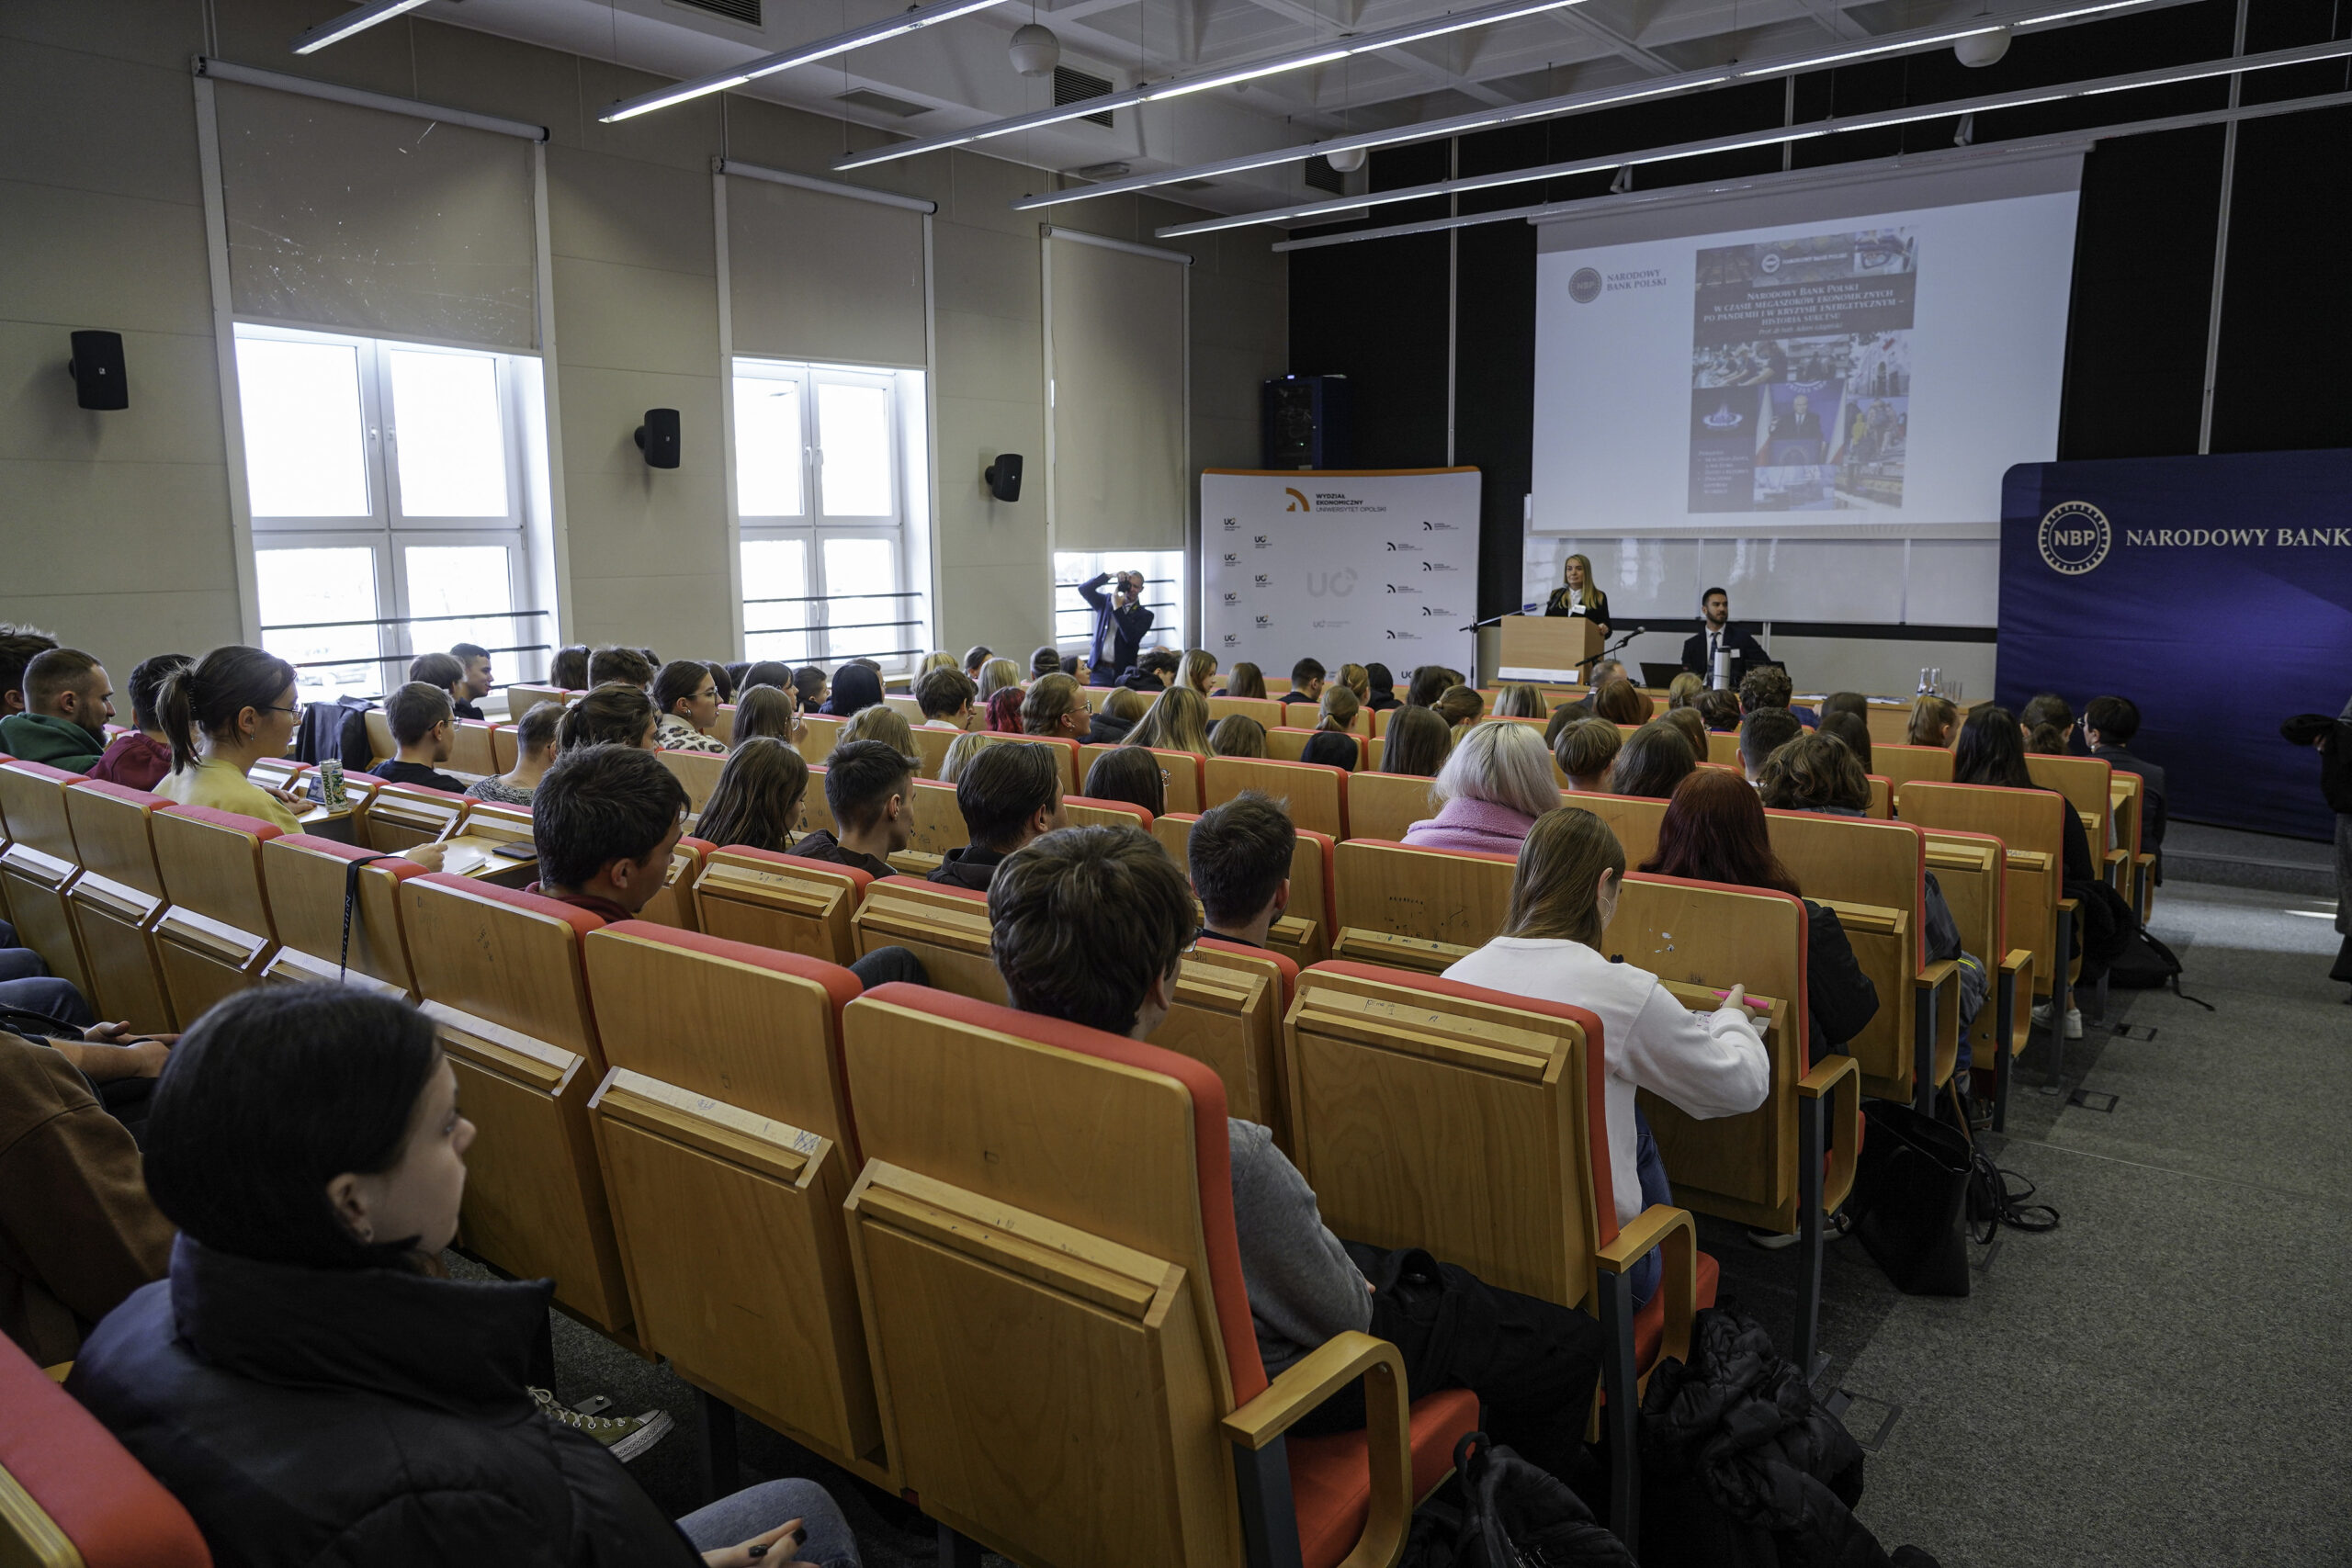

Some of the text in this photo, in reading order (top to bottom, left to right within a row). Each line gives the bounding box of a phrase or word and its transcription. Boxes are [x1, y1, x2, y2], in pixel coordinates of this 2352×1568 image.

[1608, 268, 1661, 281] NARODOWY
[1607, 277, 1667, 292] BANK POLSKI
[1747, 283, 1860, 301] NARODOWY BANK POLSKI
[2053, 530, 2097, 546] NBP
[2126, 527, 2352, 547] NARODOWY BANK
[322, 771, 333, 806] COCONAUT
